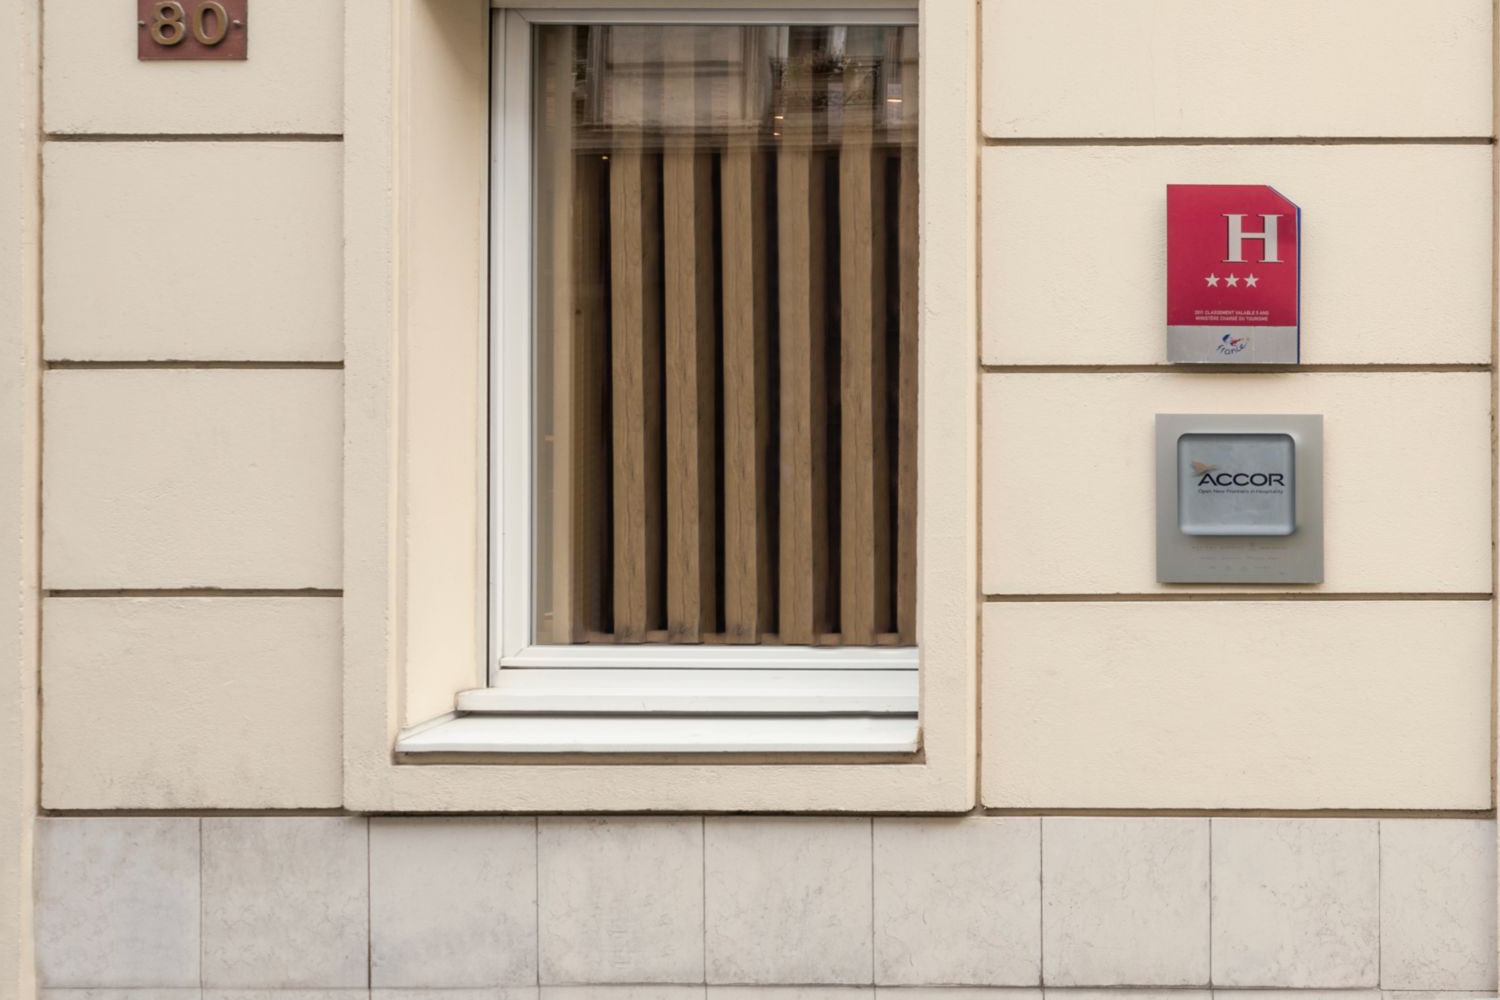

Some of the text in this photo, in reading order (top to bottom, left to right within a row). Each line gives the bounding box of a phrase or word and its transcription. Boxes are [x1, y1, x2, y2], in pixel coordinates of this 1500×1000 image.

[151, 1, 228, 45] 80
[1222, 213, 1284, 263] H
[1198, 473, 1285, 486] ACCOR
